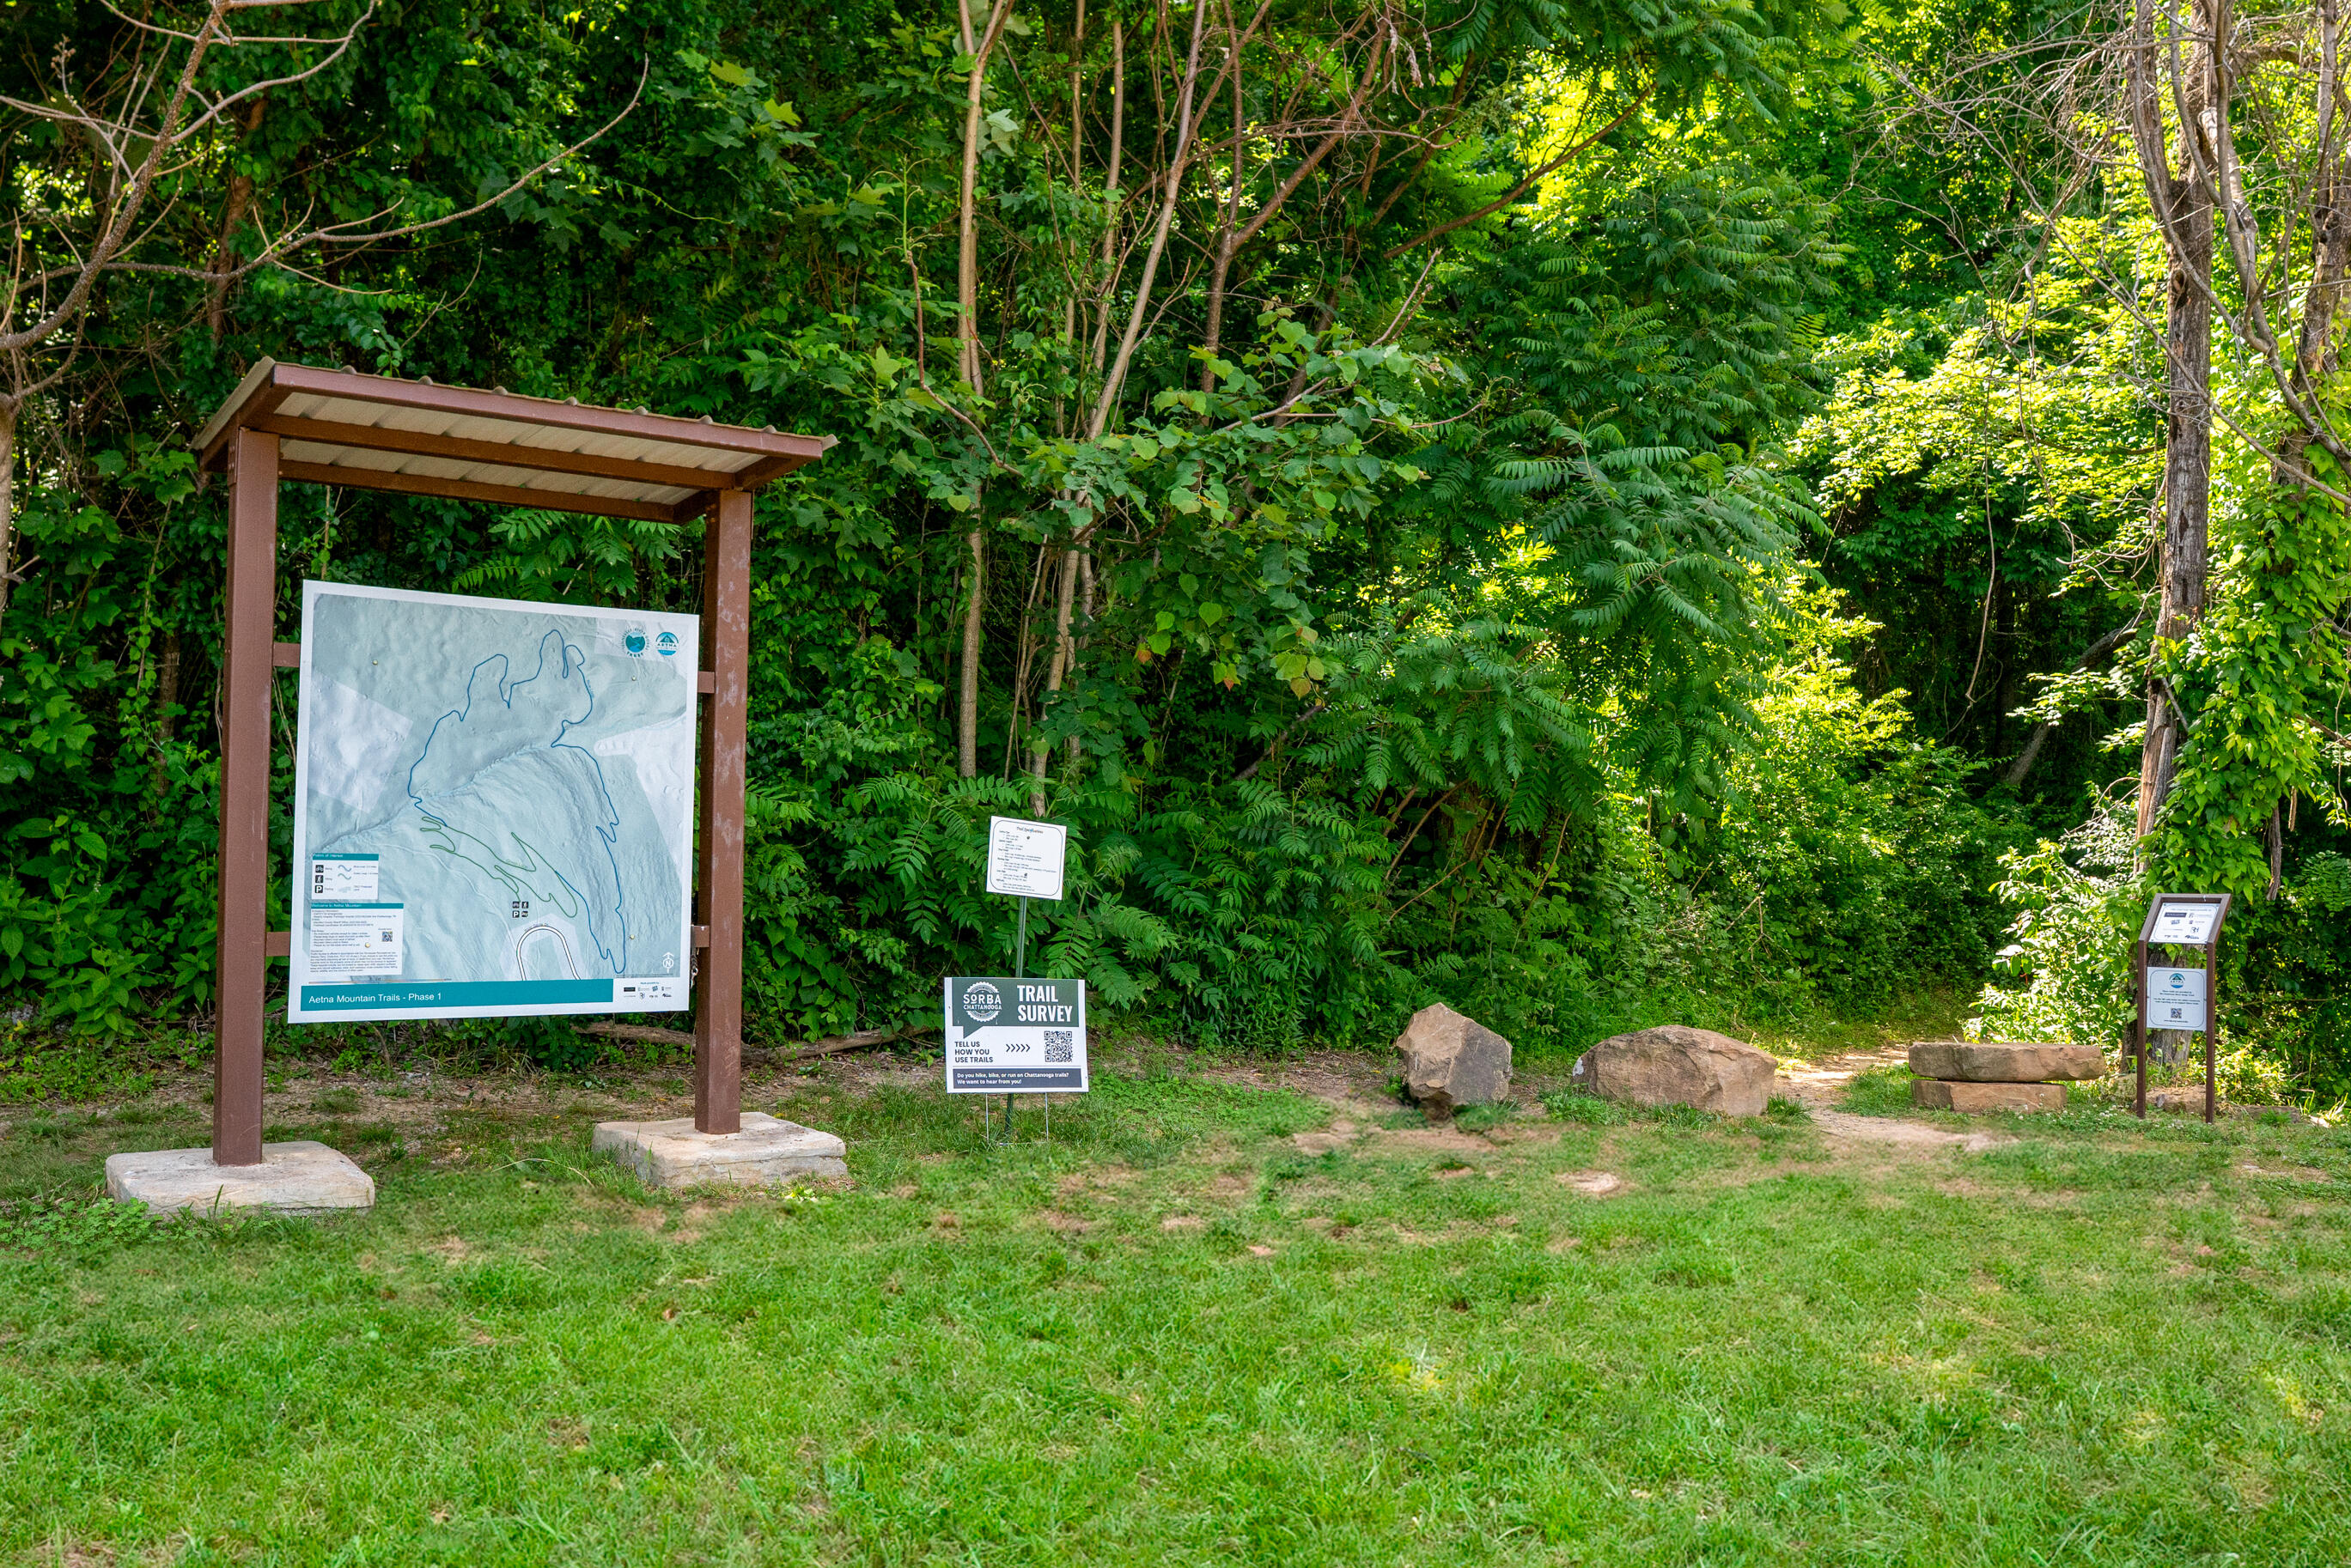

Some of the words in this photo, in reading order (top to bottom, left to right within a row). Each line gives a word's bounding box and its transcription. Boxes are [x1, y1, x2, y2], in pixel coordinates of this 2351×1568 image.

[963, 994, 1002, 1004] SORBA
[1017, 985, 1058, 1002] TRAIL
[1018, 1004, 1072, 1022] SURVEY
